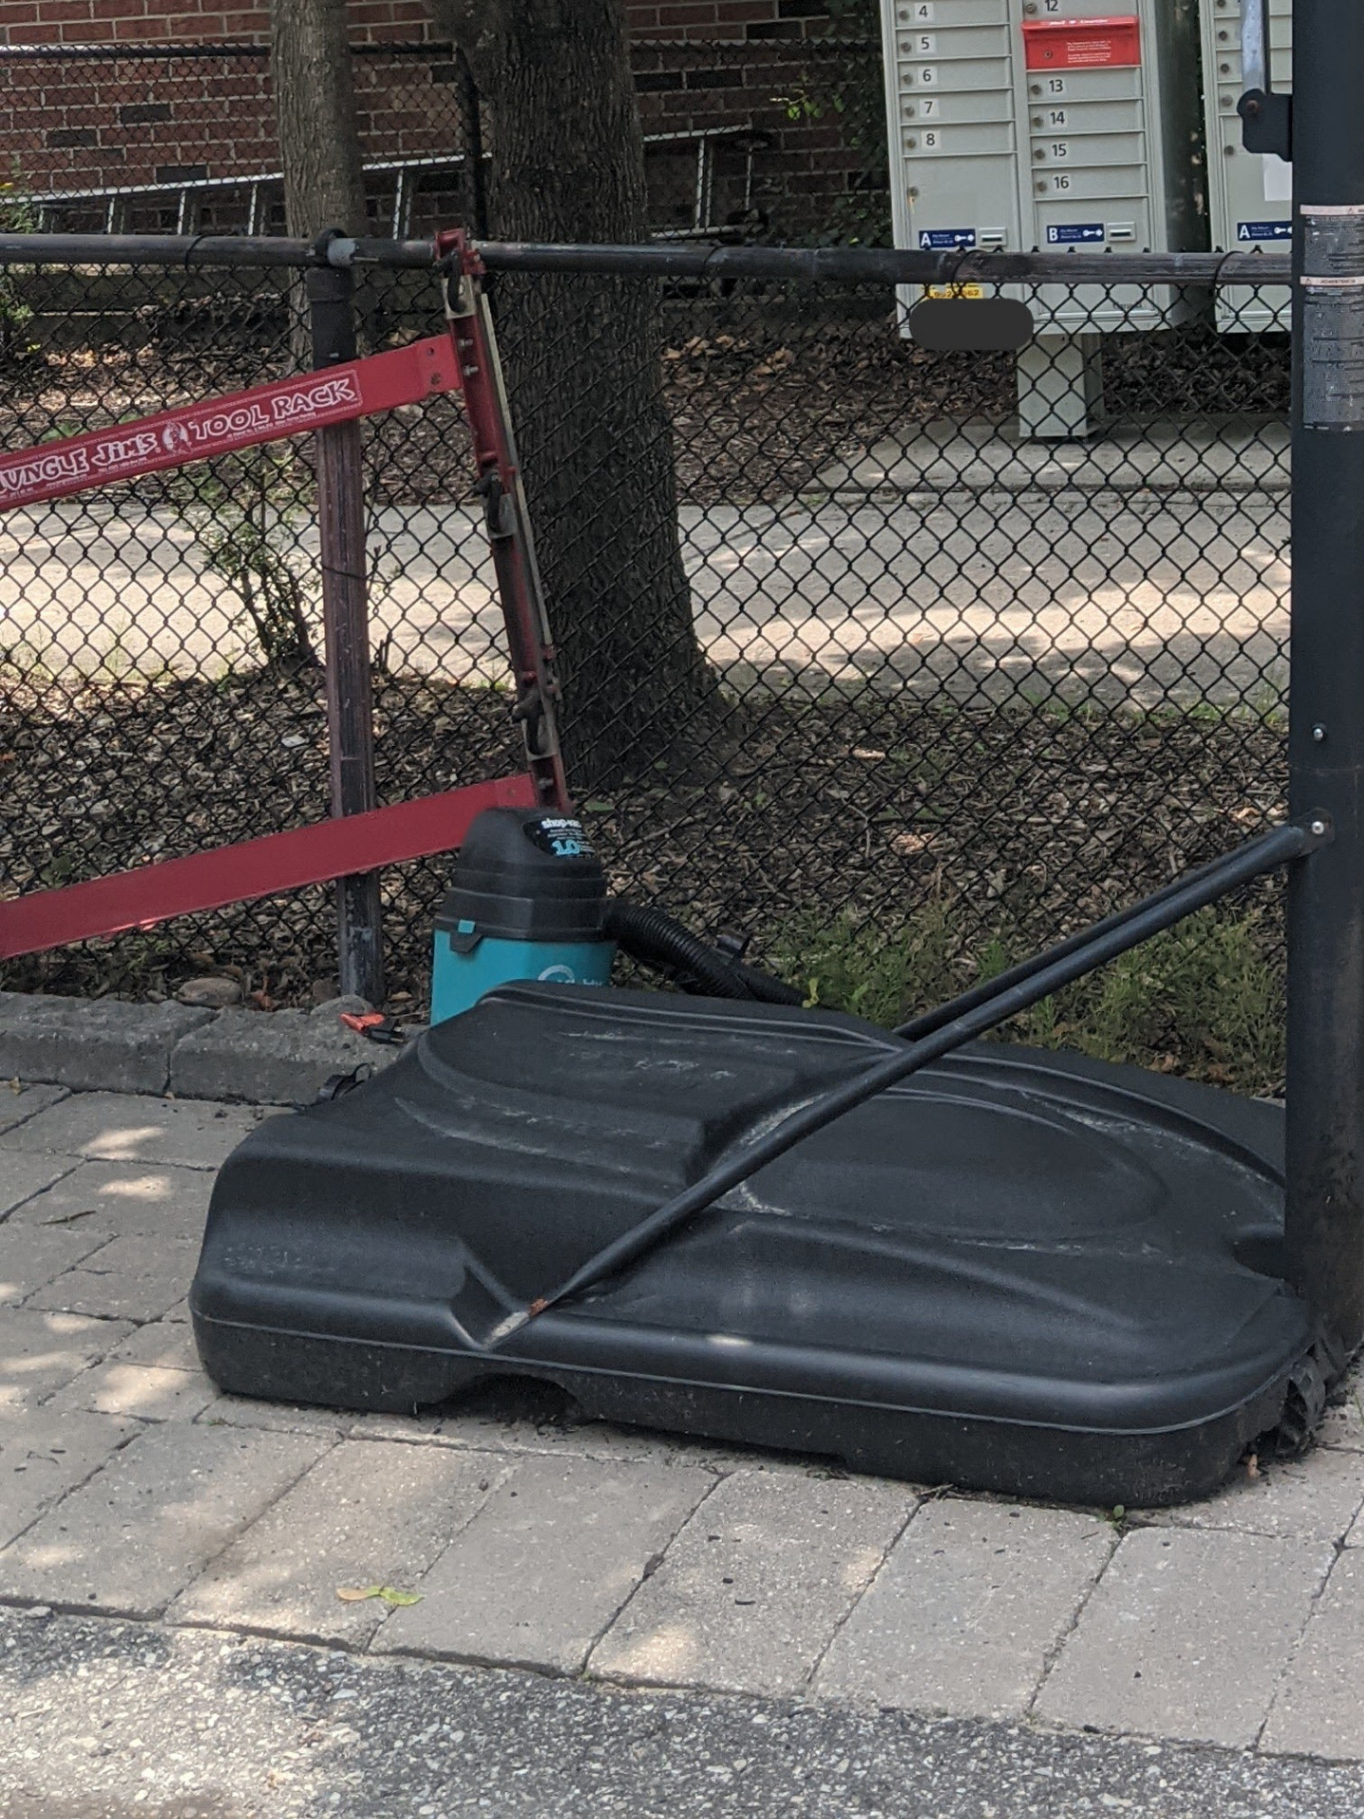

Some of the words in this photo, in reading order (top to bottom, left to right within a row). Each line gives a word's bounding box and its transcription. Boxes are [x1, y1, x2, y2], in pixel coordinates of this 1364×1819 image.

[918, 5, 928, 18] 4
[1045, 0, 1059, 12] 12
[921, 38, 930, 50] 5
[923, 69, 932, 82] 6
[1049, 79, 1063, 92] 13
[924, 101, 933, 114] 7
[1050, 111, 1066, 124] 14
[926, 133, 935, 146] 8
[1052, 143, 1067, 157] 15
[1053, 176, 1070, 189] 16
[1049, 228, 1058, 241] B
[1239, 224, 1250, 239] A
[920, 232, 932, 246] A
[189, 405, 271, 441] TOOL
[271, 378, 355, 420] RACK
